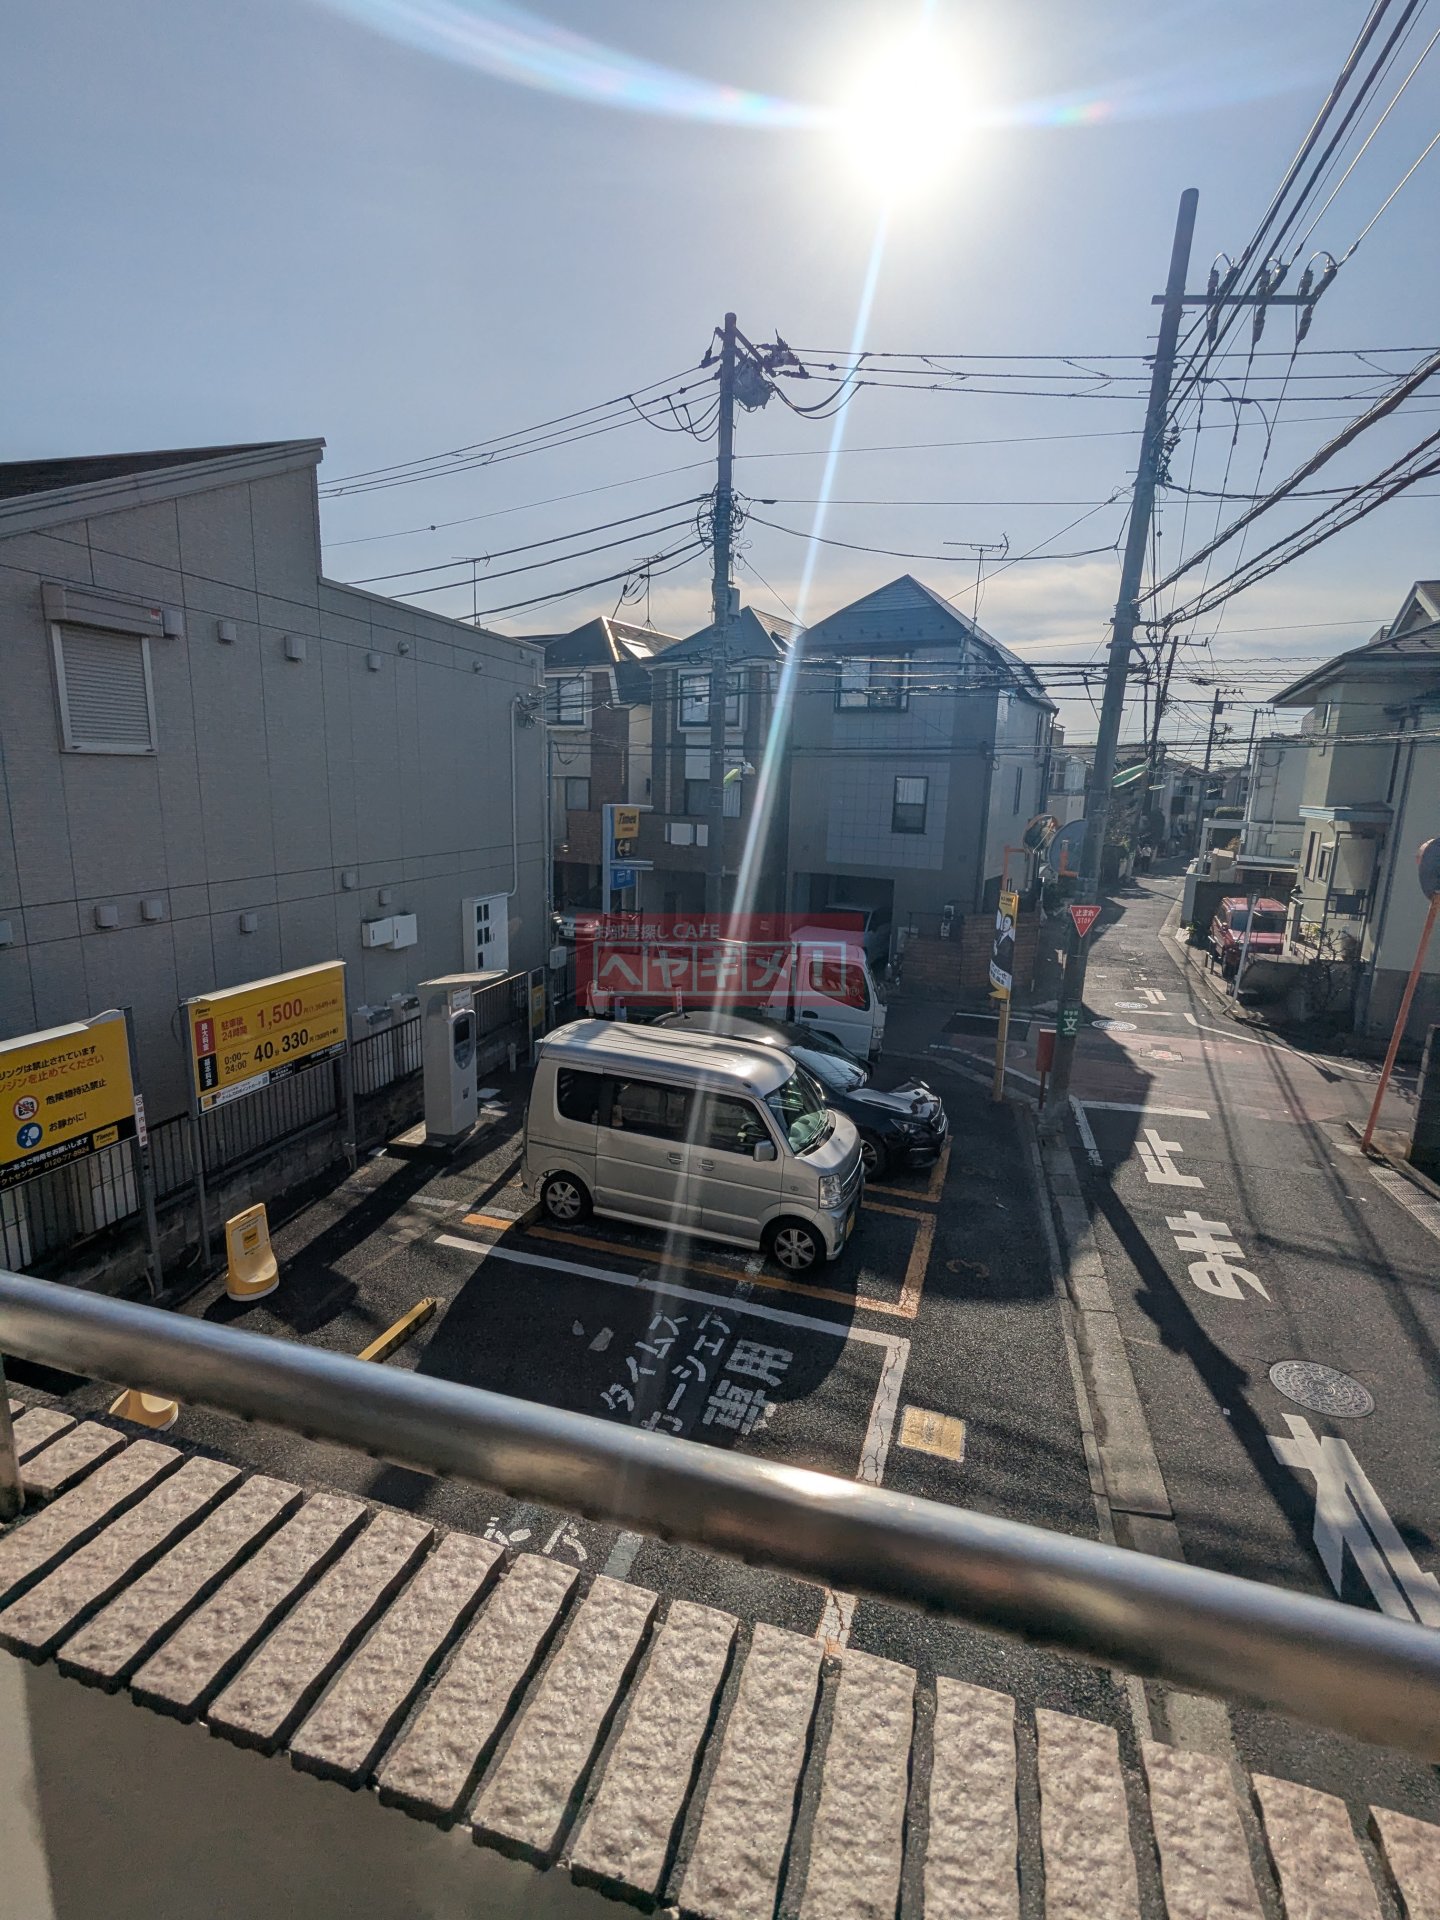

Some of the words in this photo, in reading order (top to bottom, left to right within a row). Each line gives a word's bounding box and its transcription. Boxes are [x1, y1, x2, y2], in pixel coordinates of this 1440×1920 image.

[618, 812, 637, 825] Times
[1075, 909, 1095, 917] 止まれ
[1077, 917, 1092, 925] STOP
[256, 998, 303, 1030] 1,500
[1062, 1016, 1078, 1031] 文
[281, 1029, 309, 1053] 330
[254, 1041, 274, 1062] 40
[225, 1060, 247, 1075] 24:00
[45, 1078, 106, 1105] 危険物持込禁止
[702, 1338, 795, 1436] 専用
